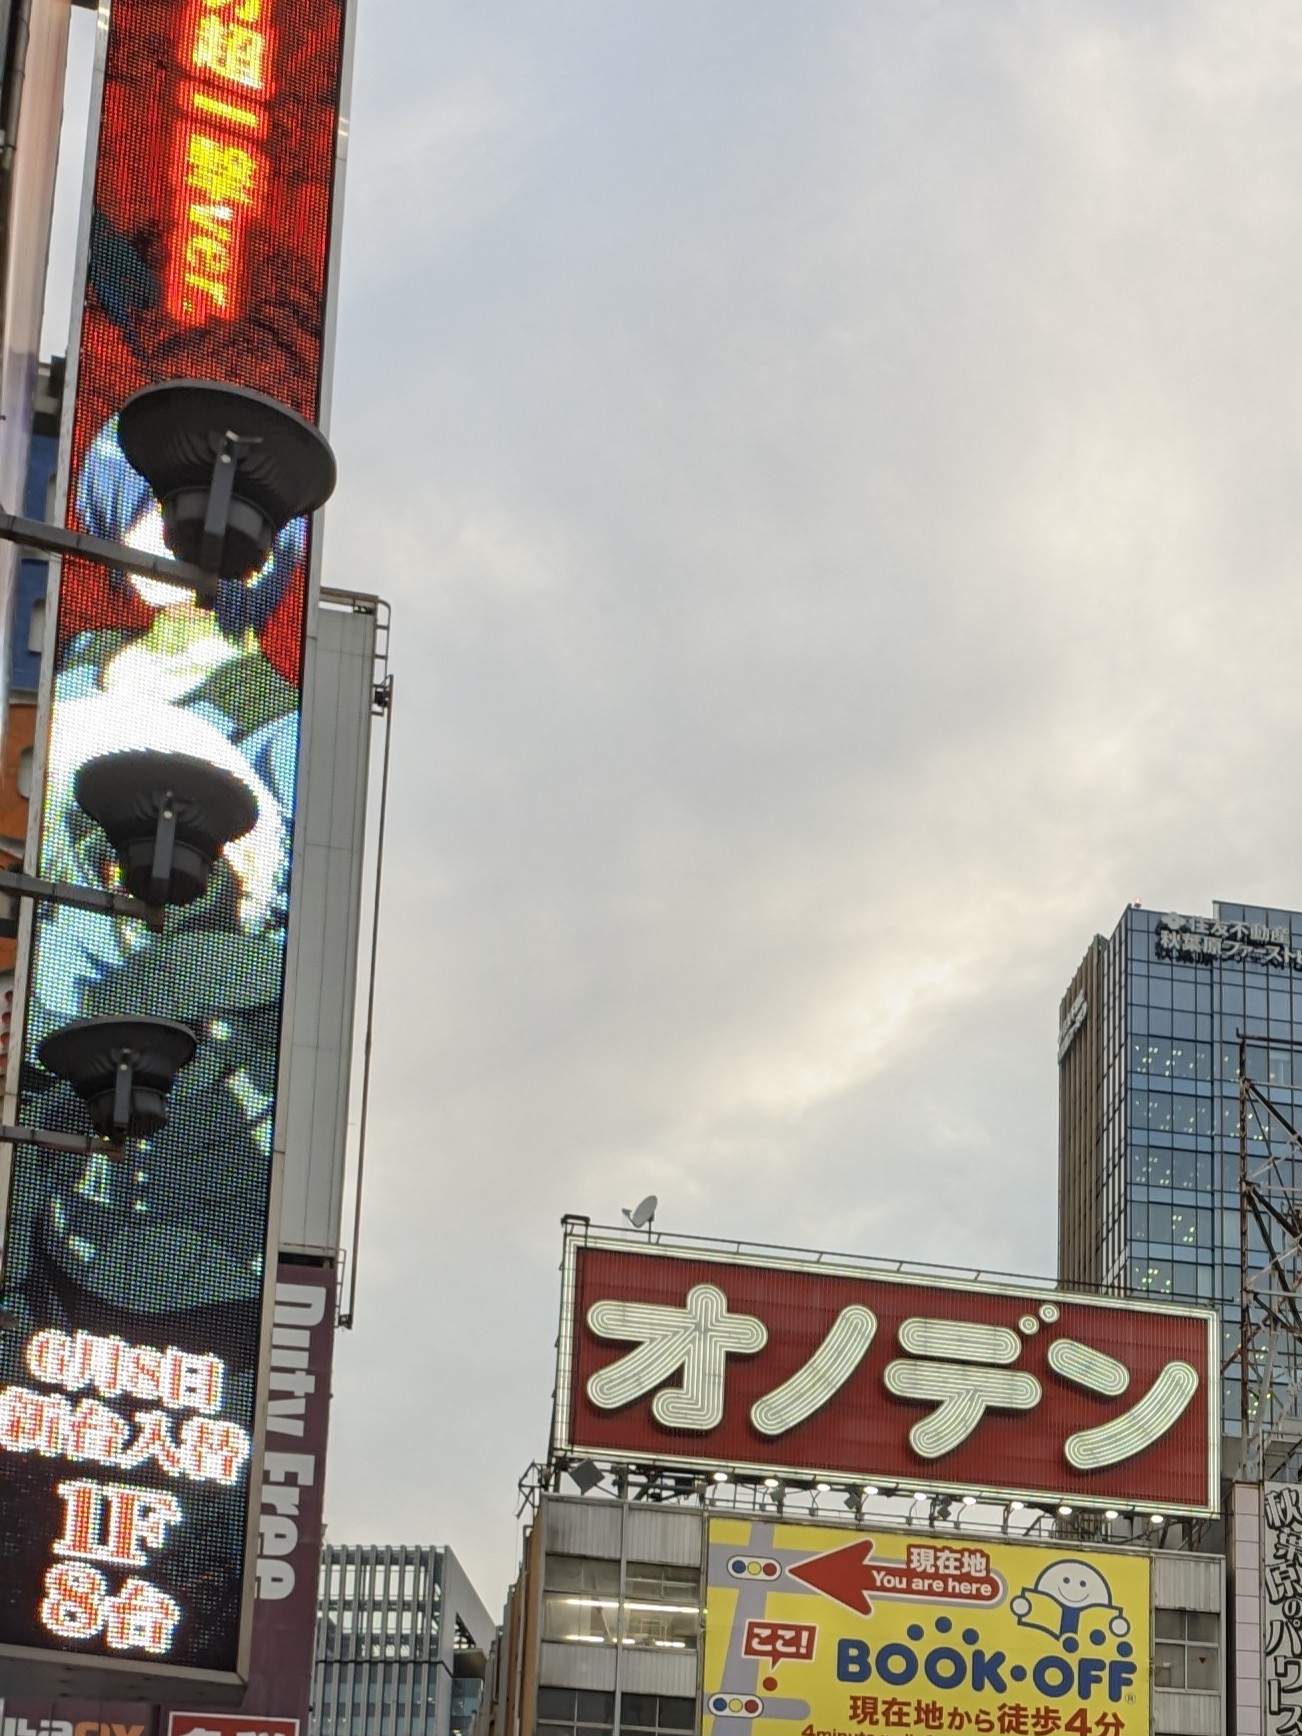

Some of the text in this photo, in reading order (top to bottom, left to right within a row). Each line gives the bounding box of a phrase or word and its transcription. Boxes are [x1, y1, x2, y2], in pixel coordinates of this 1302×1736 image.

[1189, 917, 1289, 944] 住友不動産
[586, 1283, 1200, 1470] オノデン
[254, 1282, 327, 1601] Duty Free
[908, 1544, 988, 1579] 現在地
[872, 1570, 993, 1598] You are here
[751, 1625, 809, 1654] ここ!
